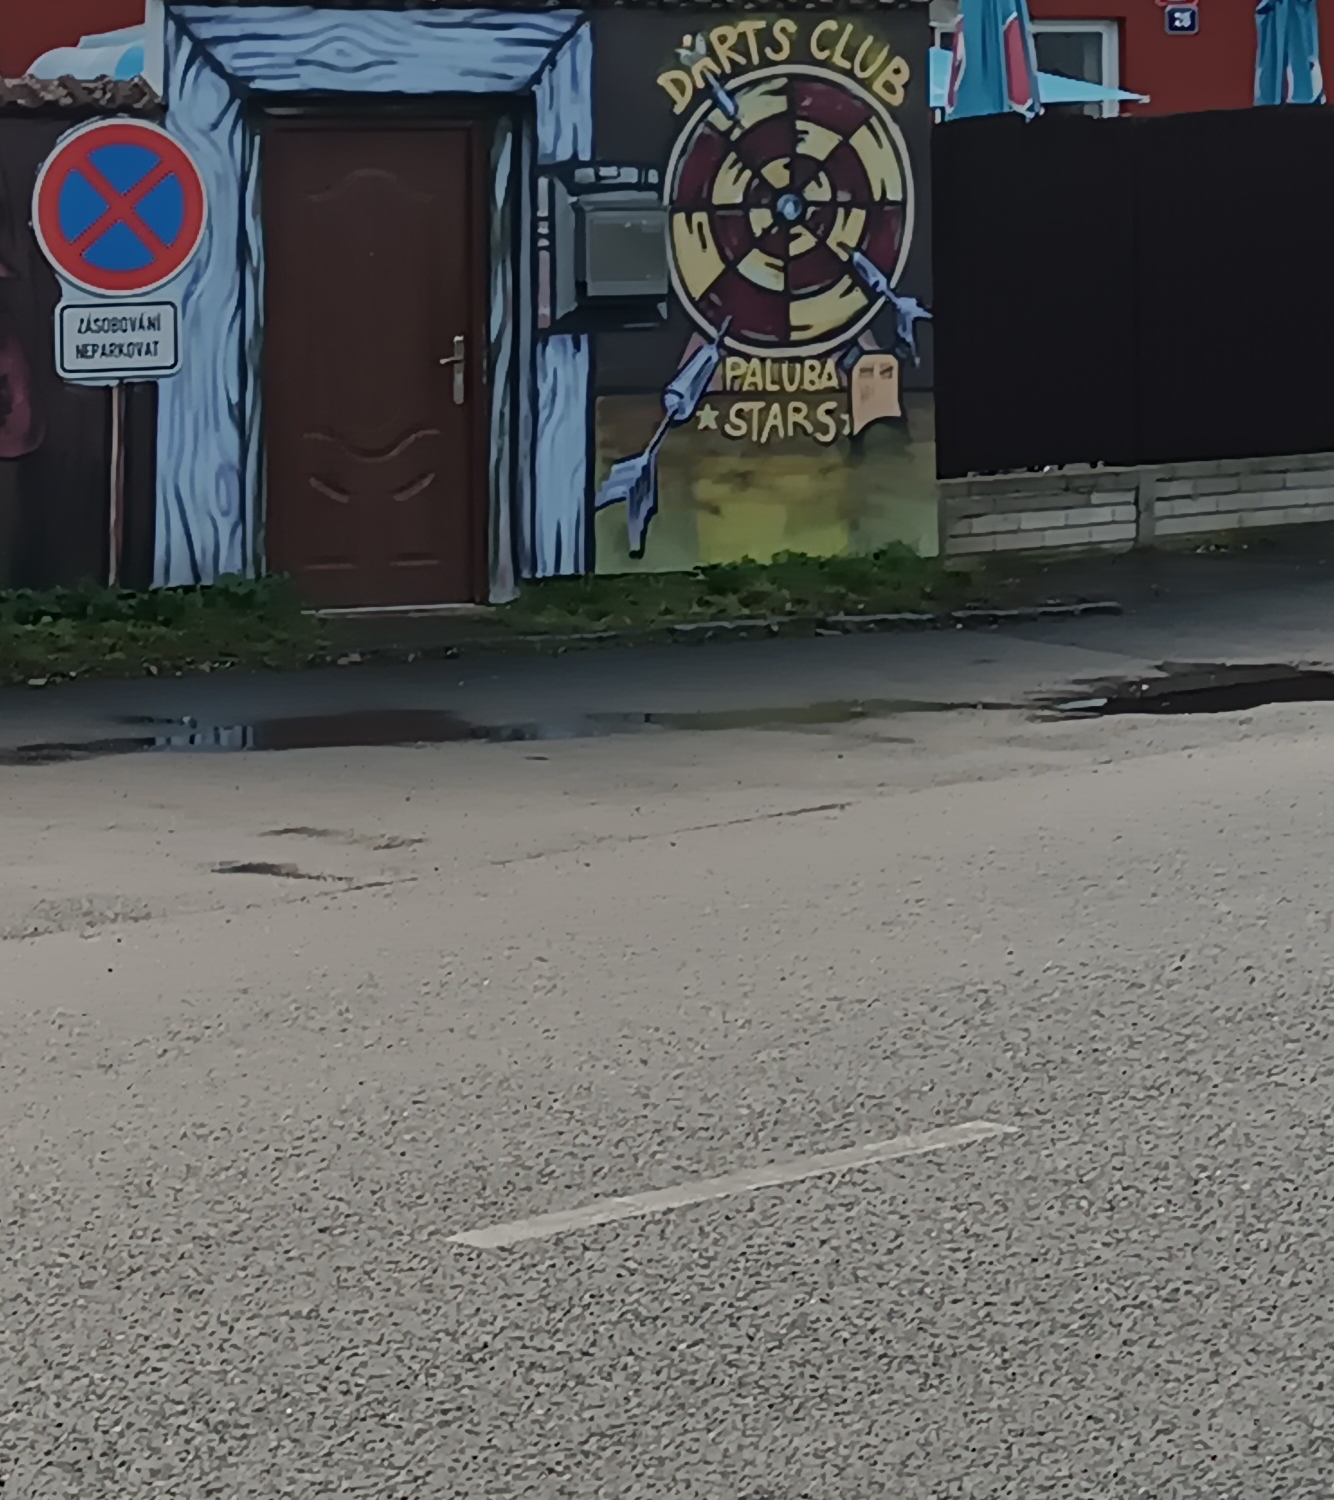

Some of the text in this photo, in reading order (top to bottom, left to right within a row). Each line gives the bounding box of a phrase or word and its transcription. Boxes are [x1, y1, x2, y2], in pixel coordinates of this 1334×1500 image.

[656, 17, 910, 115] DARTS CLUB
[77, 312, 162, 334] ZÁSOBOVÁNÍ
[75, 340, 160, 360] NEPARKOVAT
[725, 356, 840, 392] PALUBA
[723, 400, 839, 444] STARS
